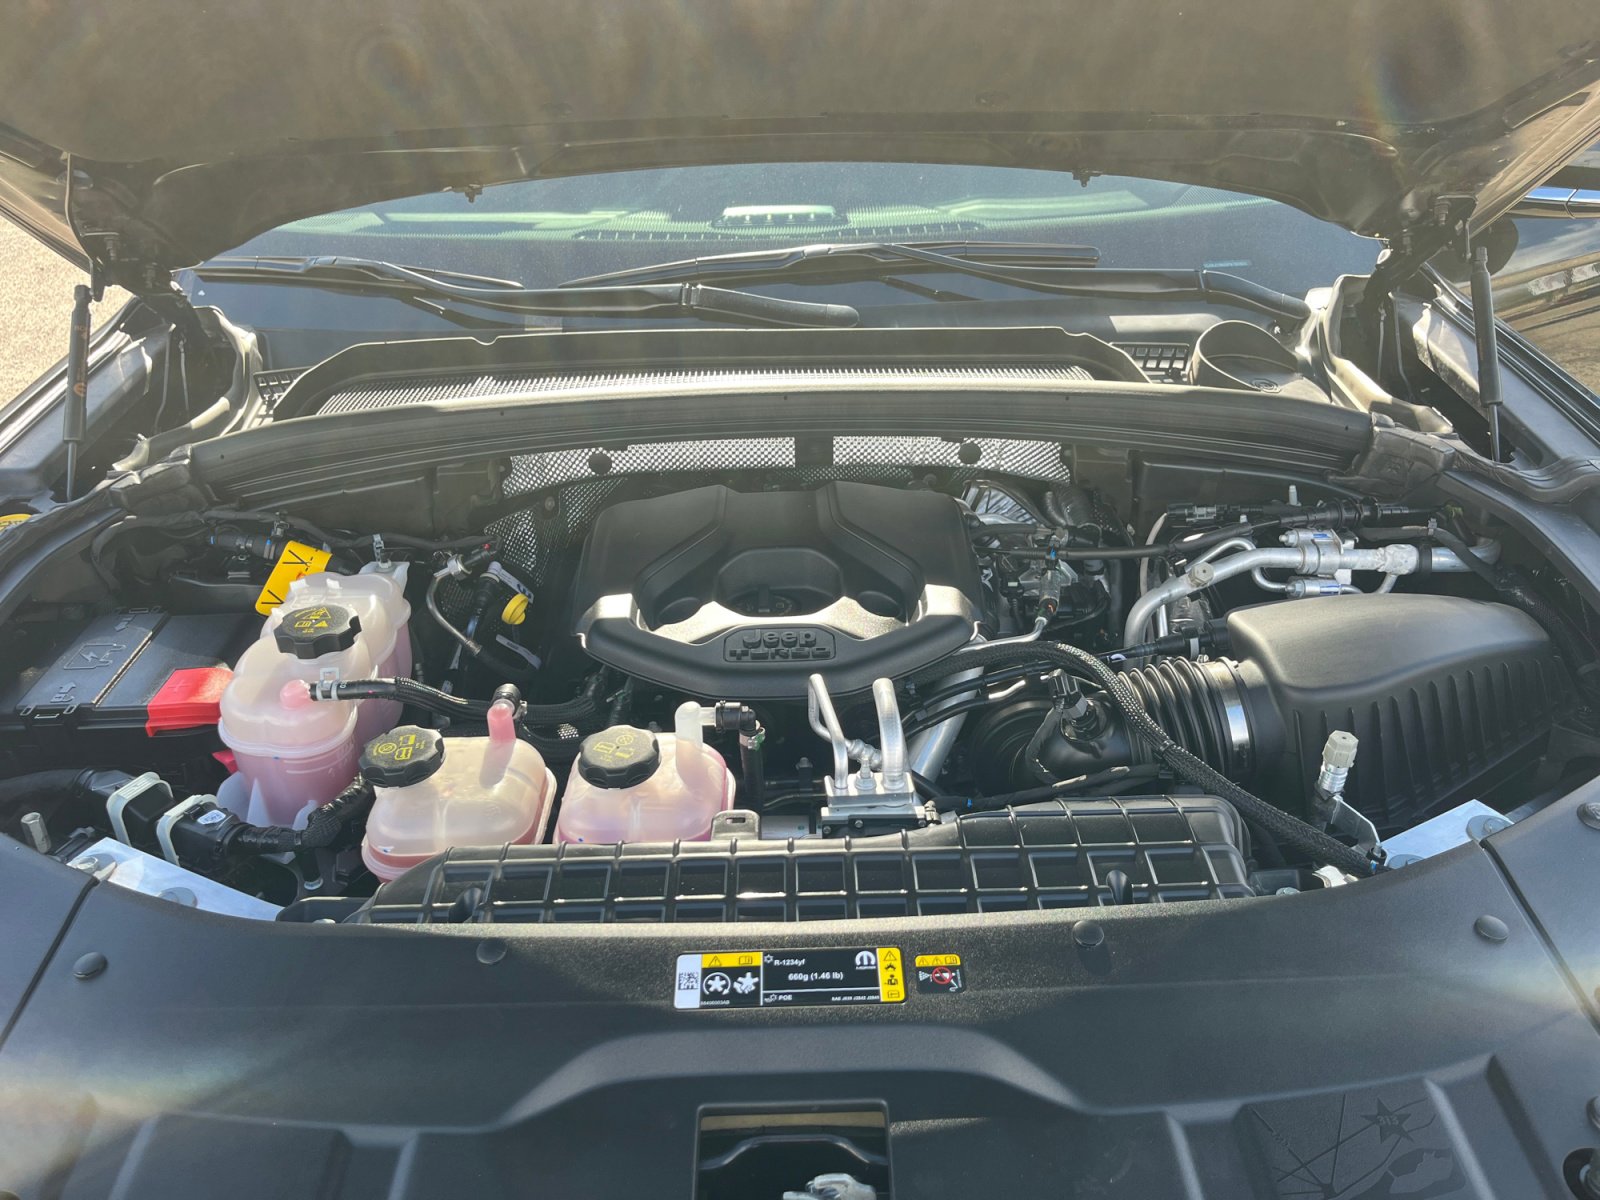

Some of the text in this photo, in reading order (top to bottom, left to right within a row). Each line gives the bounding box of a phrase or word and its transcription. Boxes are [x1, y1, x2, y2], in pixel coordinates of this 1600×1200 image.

[742, 628, 816, 648] Jeep
[774, 958, 806, 966] R-1234yf
[832, 971, 844, 981] lb)
